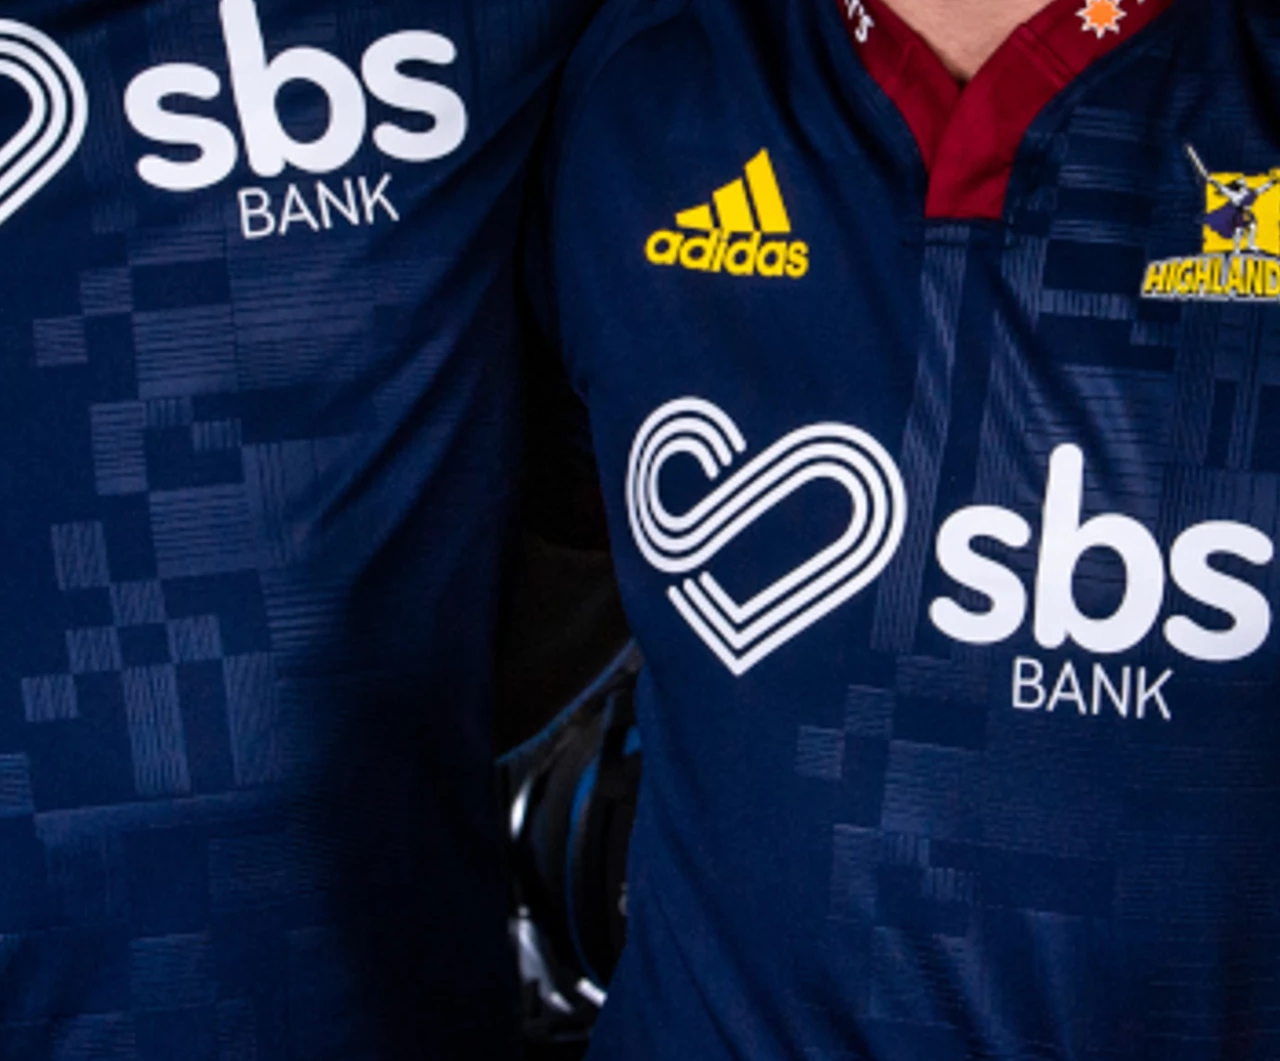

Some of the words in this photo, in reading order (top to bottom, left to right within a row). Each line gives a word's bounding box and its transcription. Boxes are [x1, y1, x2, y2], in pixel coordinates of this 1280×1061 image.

[236, 172, 400, 239] BANK
[644, 227, 810, 279] adidas
[928, 442, 1274, 662] sbs
[1011, 656, 1174, 720] BANK
